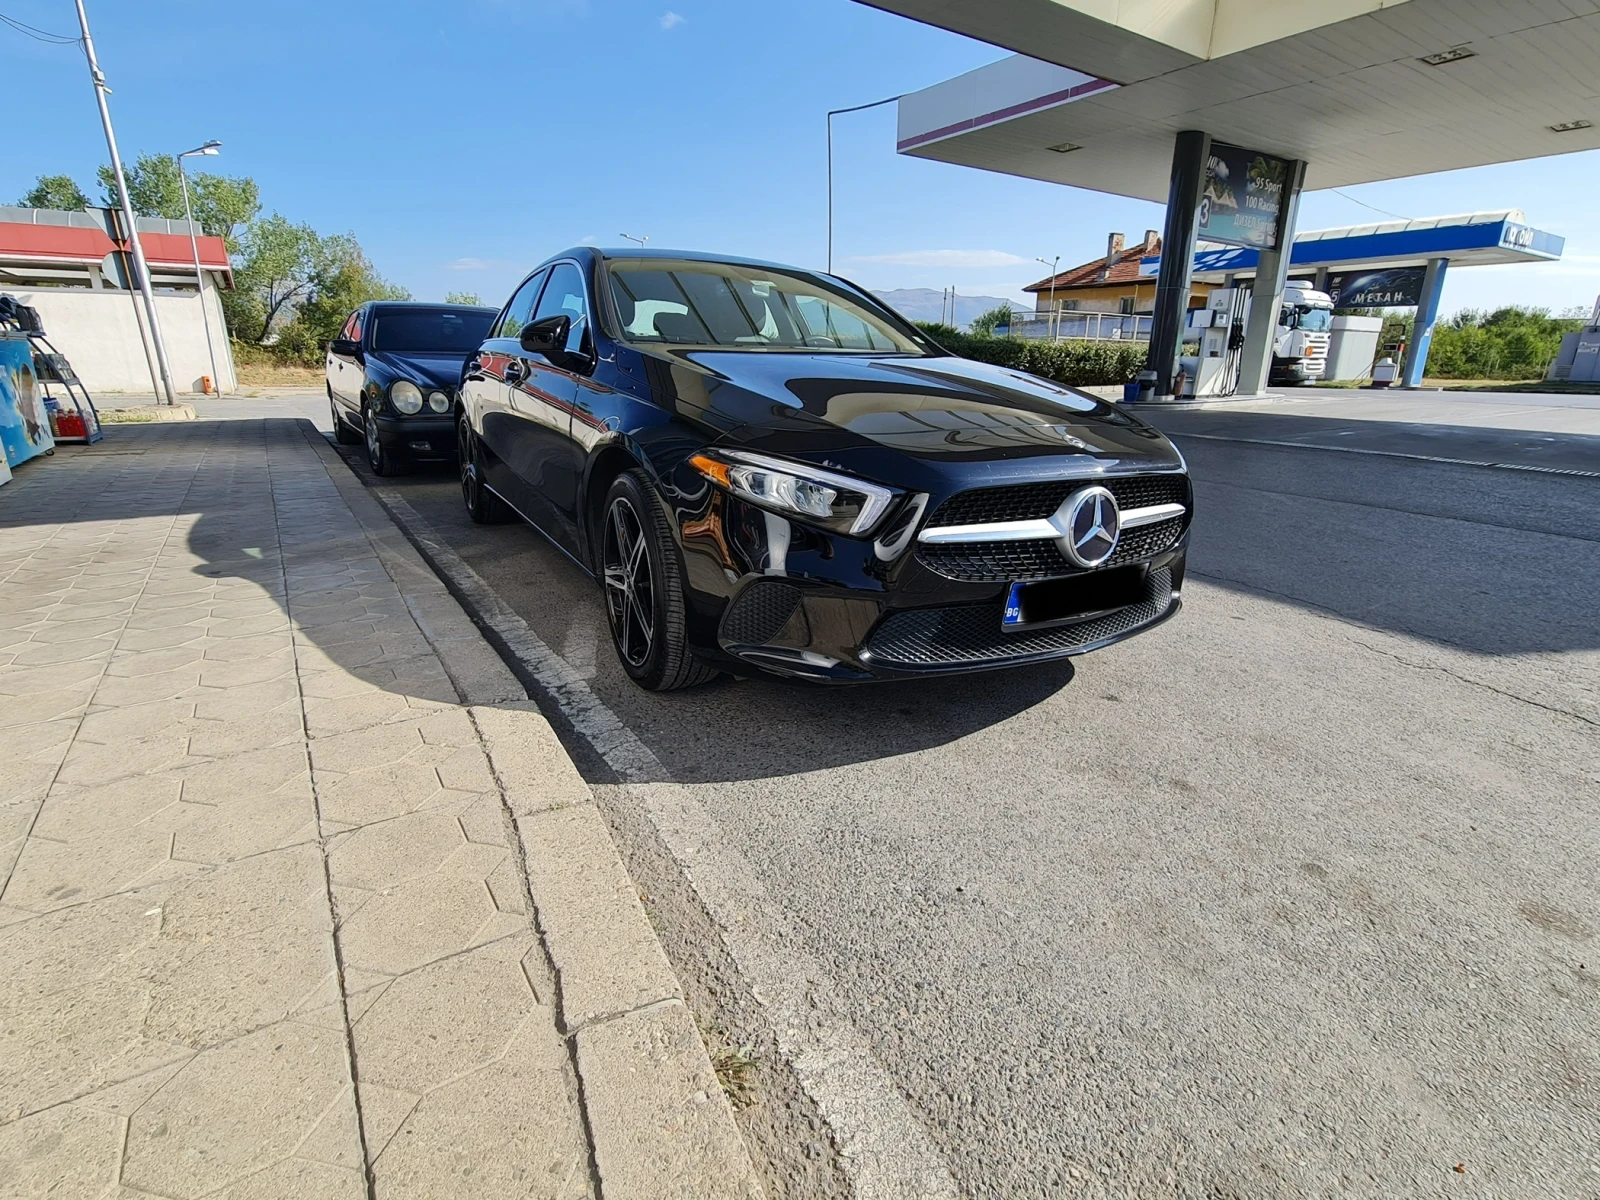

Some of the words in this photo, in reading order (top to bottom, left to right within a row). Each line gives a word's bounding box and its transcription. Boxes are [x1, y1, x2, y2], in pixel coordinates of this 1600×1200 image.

[1255, 177, 1264, 189] 95
[1265, 179, 1282, 193] Sport
[1200, 198, 1210, 224] 3
[1246, 196, 1258, 209] 100
[1258, 198, 1279, 215] Racing
[1331, 291, 1339, 303] 5
[1354, 292, 1403, 304] МЕТАН
[1006, 607, 1019, 618] BG
